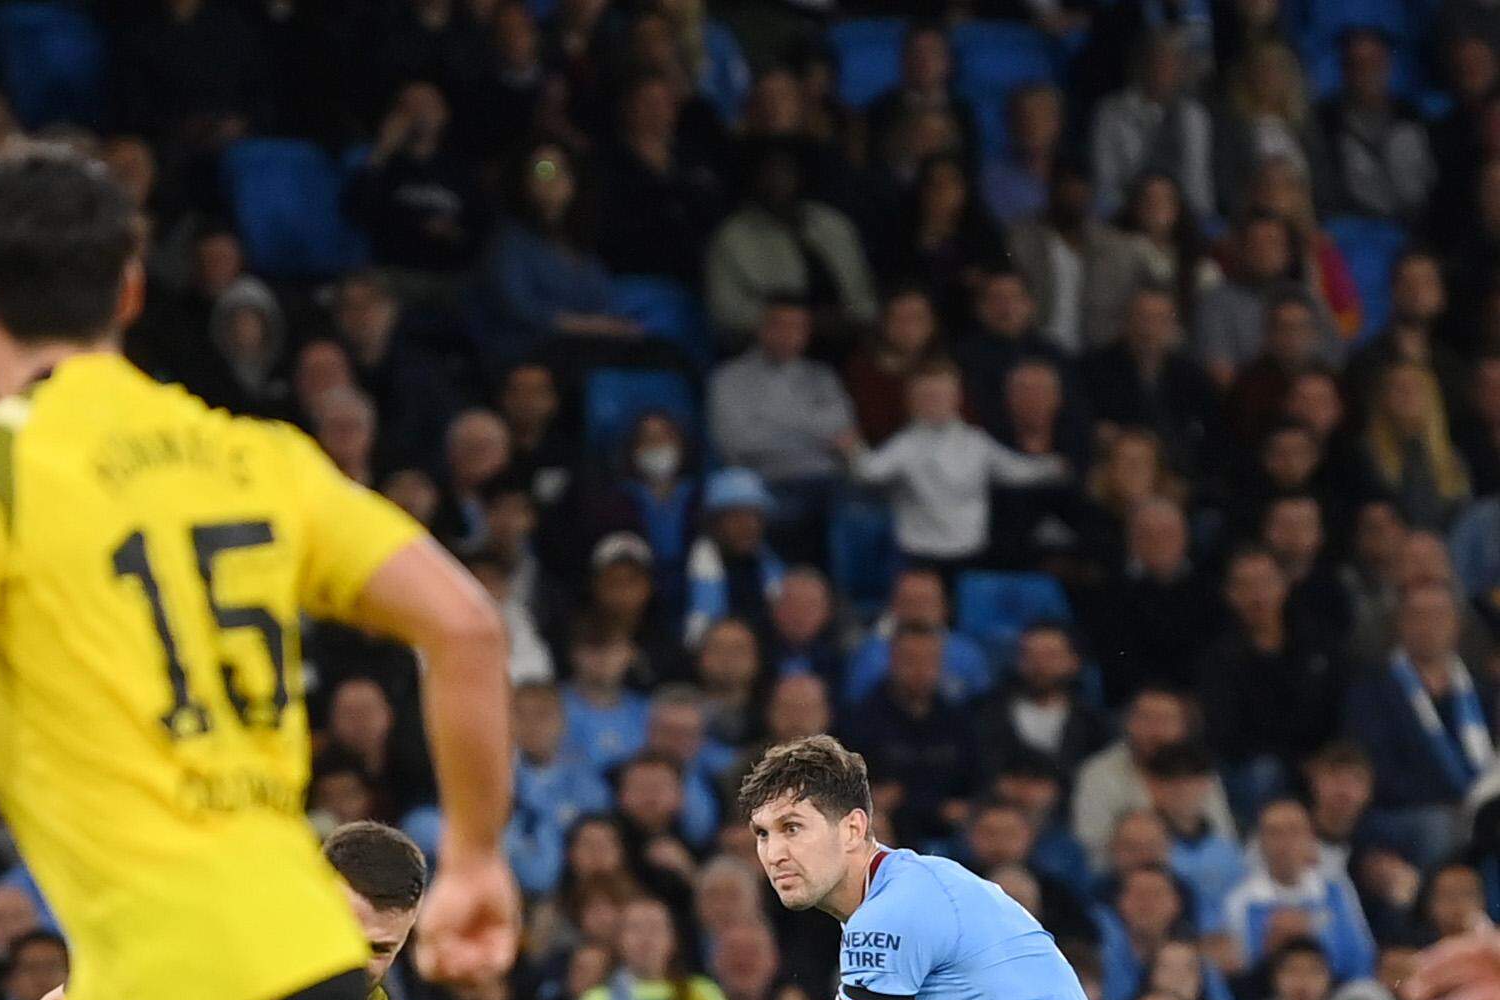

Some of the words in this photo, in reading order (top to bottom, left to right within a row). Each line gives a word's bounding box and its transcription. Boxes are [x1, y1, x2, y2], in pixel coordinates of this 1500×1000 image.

[112, 519, 290, 738] 15
[842, 931, 902, 951] NEXEN
[845, 950, 887, 968] TIRE
